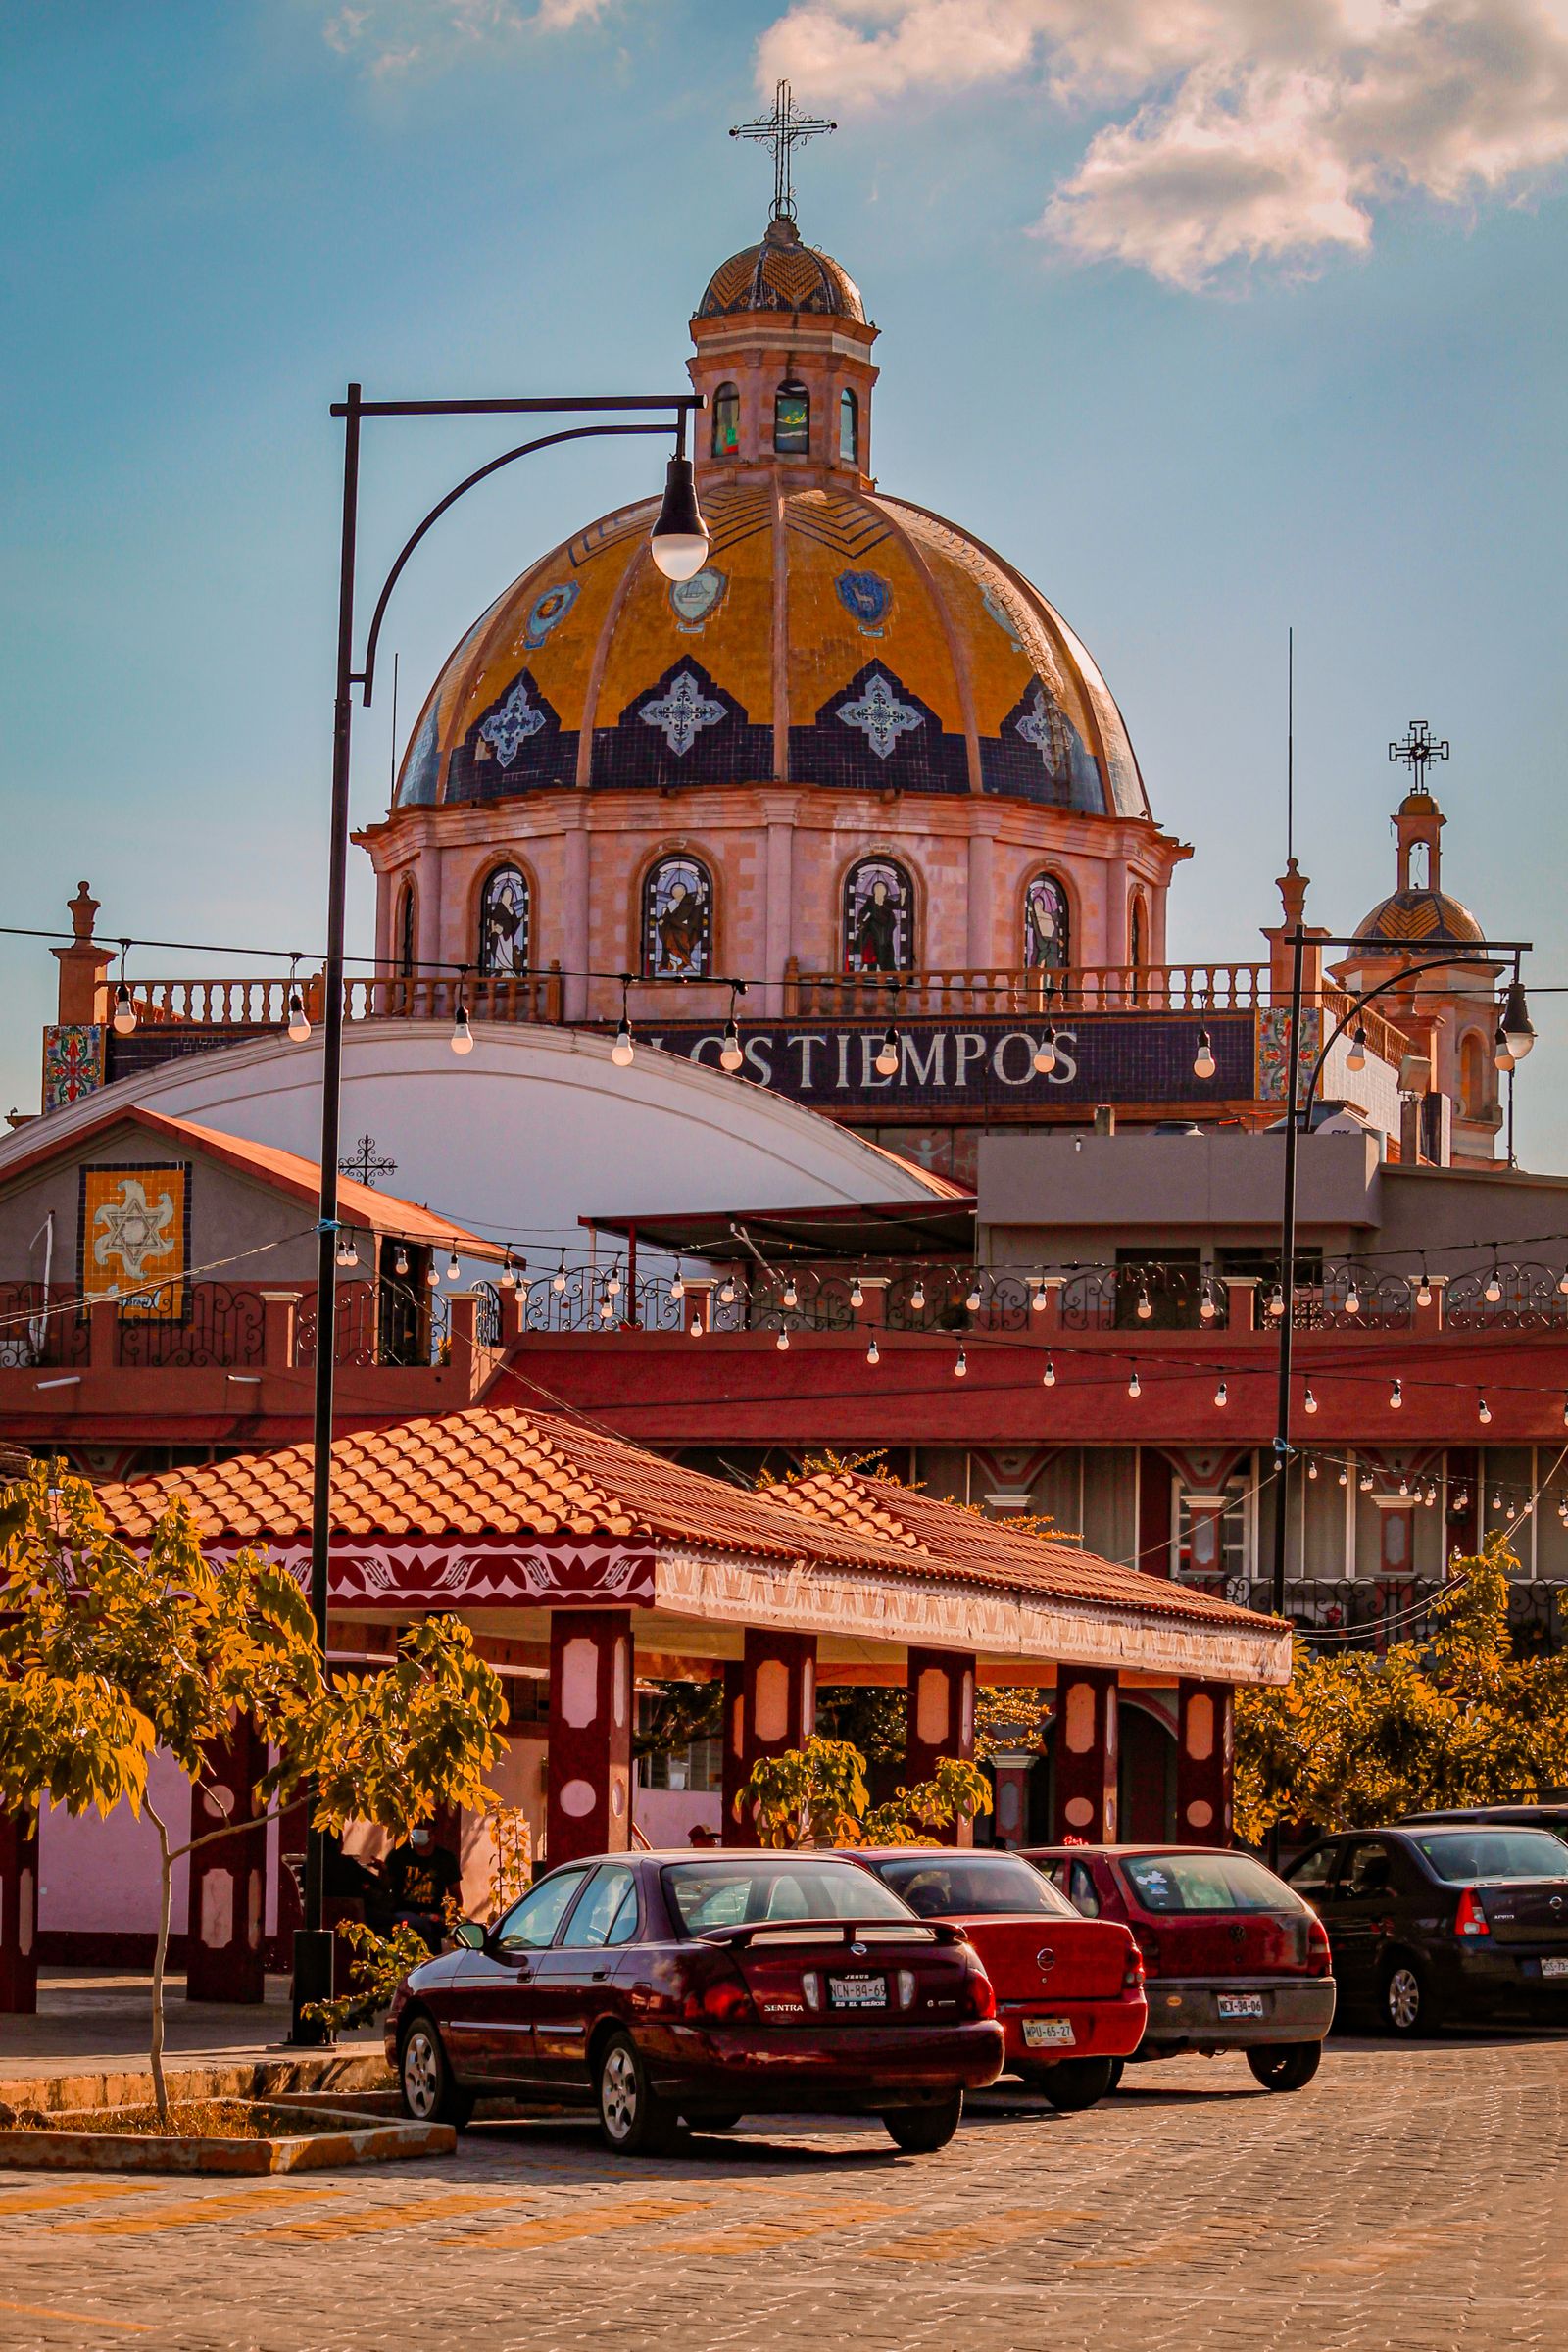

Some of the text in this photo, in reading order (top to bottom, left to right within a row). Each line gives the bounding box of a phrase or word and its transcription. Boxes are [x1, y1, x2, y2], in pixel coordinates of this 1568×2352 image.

[651, 1032, 1078, 1088] OS TIEMPOS
[831, 1984, 887, 1998] NCN-84-69
